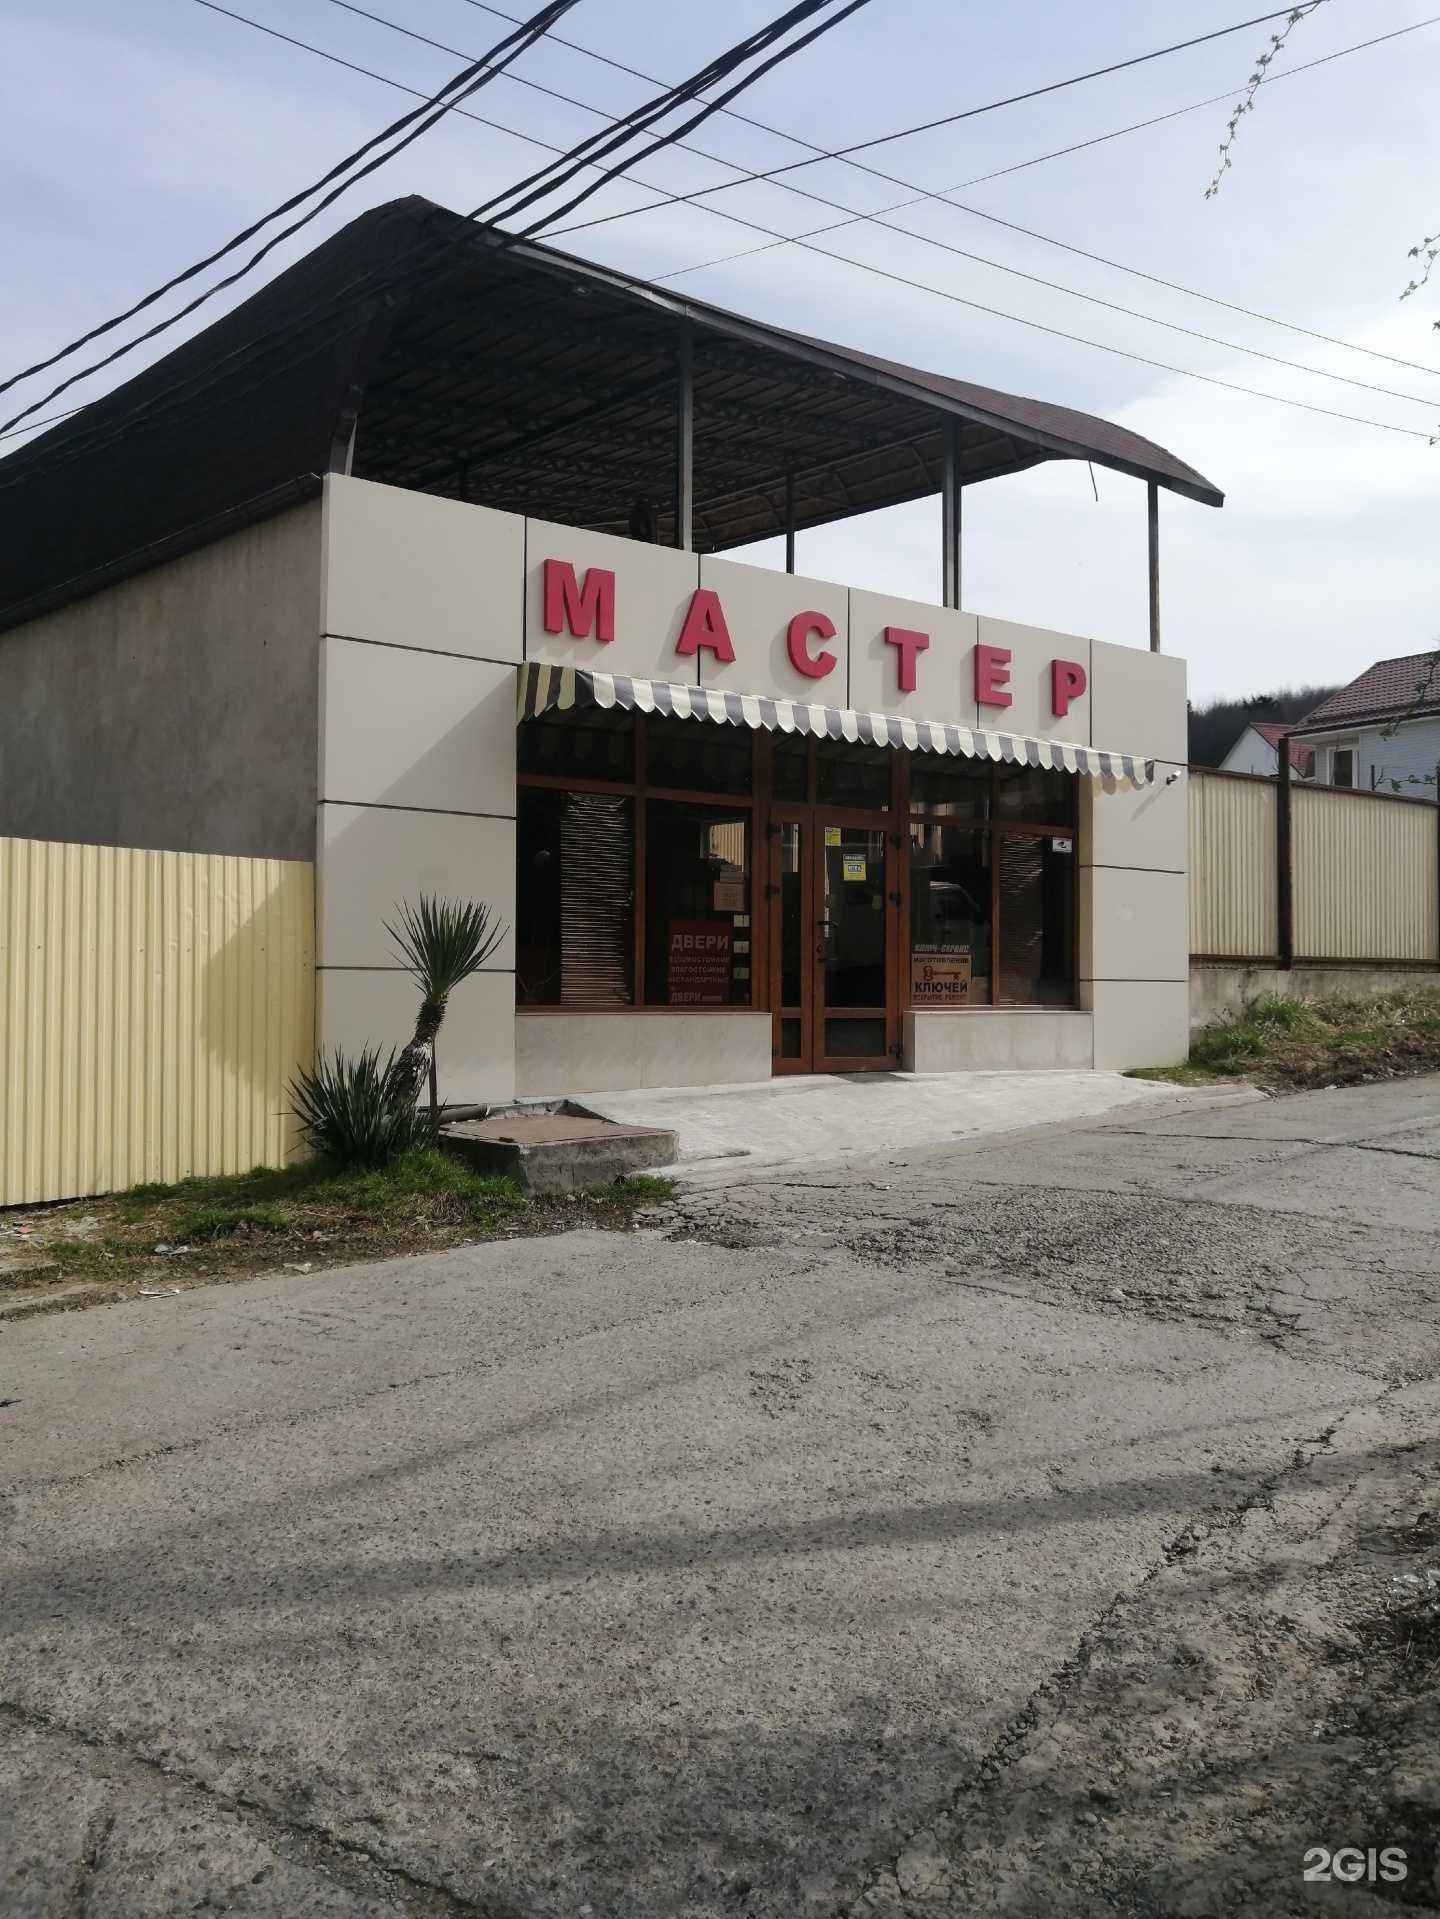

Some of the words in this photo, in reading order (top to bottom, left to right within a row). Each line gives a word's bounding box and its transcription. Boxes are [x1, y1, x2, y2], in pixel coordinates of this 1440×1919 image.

[543, 558, 1087, 717] МАСТЕР
[672, 934, 729, 952] ДВЕРИ
[915, 980, 968, 993] КЛЮЧЕЙ
